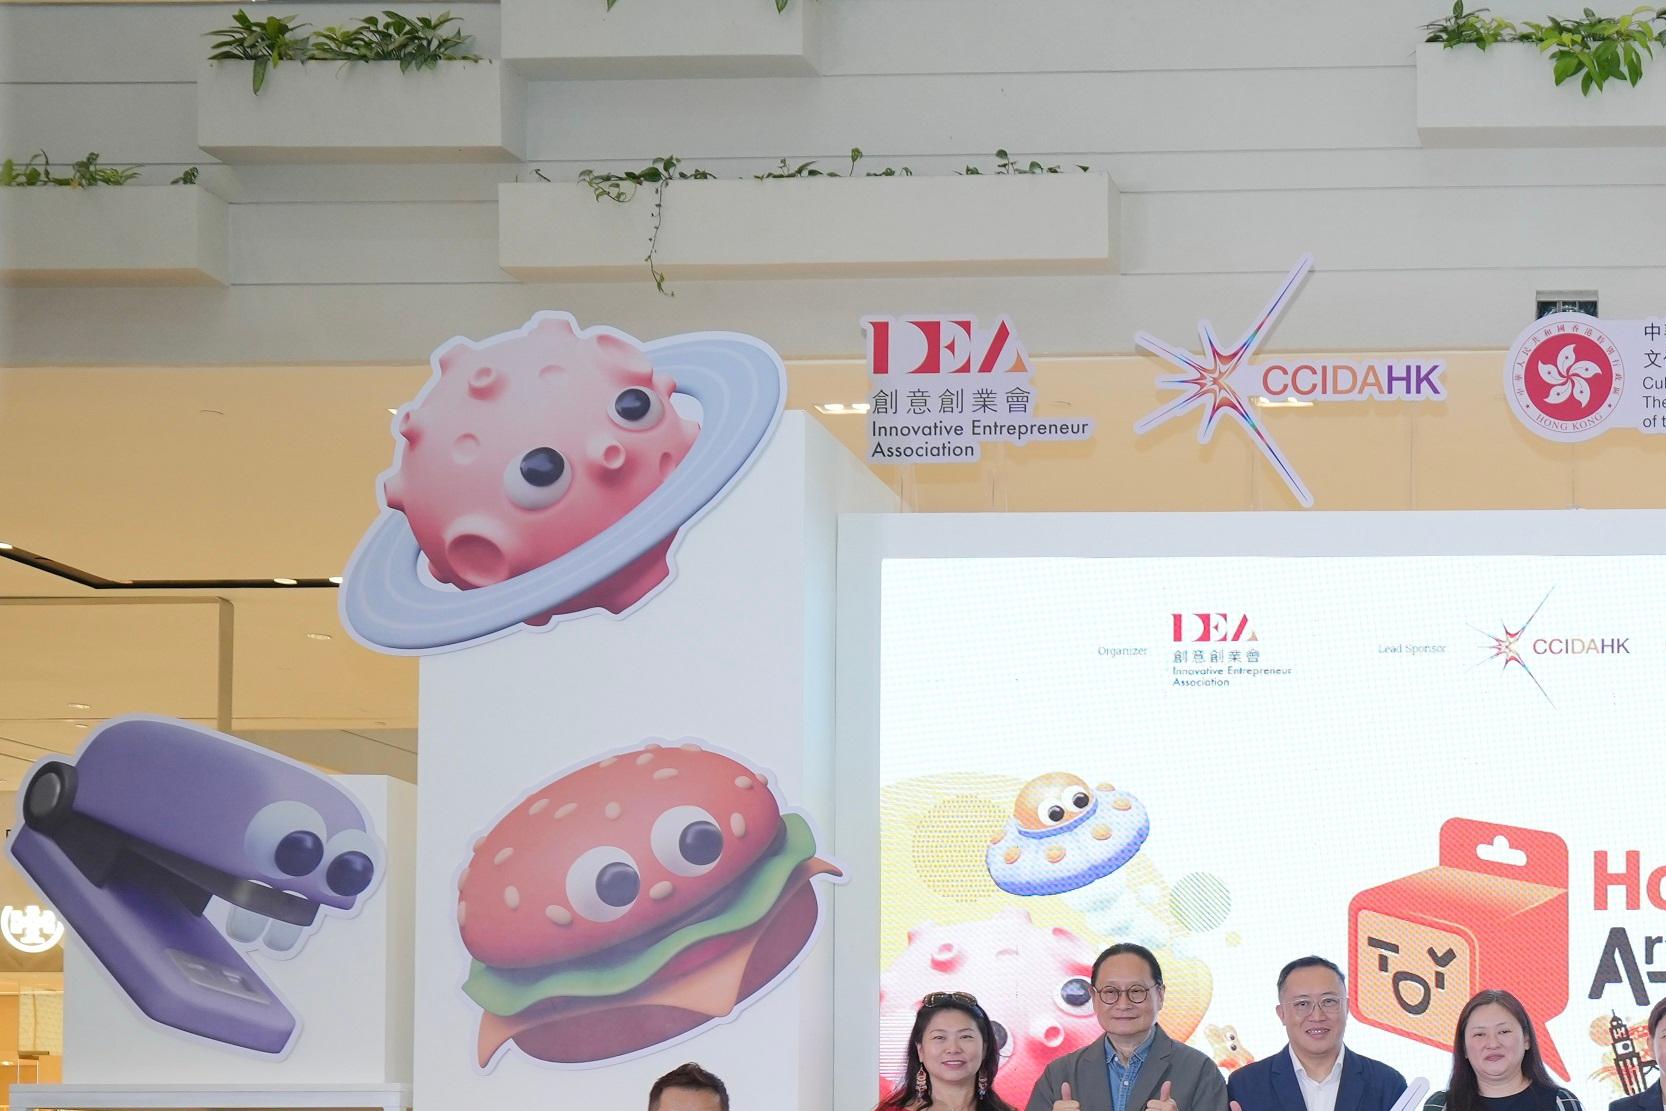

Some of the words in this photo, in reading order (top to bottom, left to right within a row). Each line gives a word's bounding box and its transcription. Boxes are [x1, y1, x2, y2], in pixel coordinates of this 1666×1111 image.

[868, 320, 1028, 374] IDEA
[1262, 364, 1440, 395] CCIDAHK
[872, 387, 1031, 415] 創意創業會
[1536, 413, 1568, 431] HONG
[1572, 413, 1604, 431] KONG
[1642, 414, 1657, 428] of
[872, 420, 964, 437] Innovative
[972, 419, 1089, 440] Entrepreneur
[871, 442, 974, 458] Association
[1171, 613, 1258, 642] IDEA
[1378, 644, 1402, 654] Lead
[1405, 644, 1446, 655] Sponsor
[1533, 638, 1630, 654] CCIDAHK
[1173, 649, 1260, 663] 創意創業會
[1173, 666, 1223, 675] Innovative
[1228, 666, 1292, 677] Entrepreneur
[1172, 677, 1230, 687] Association
